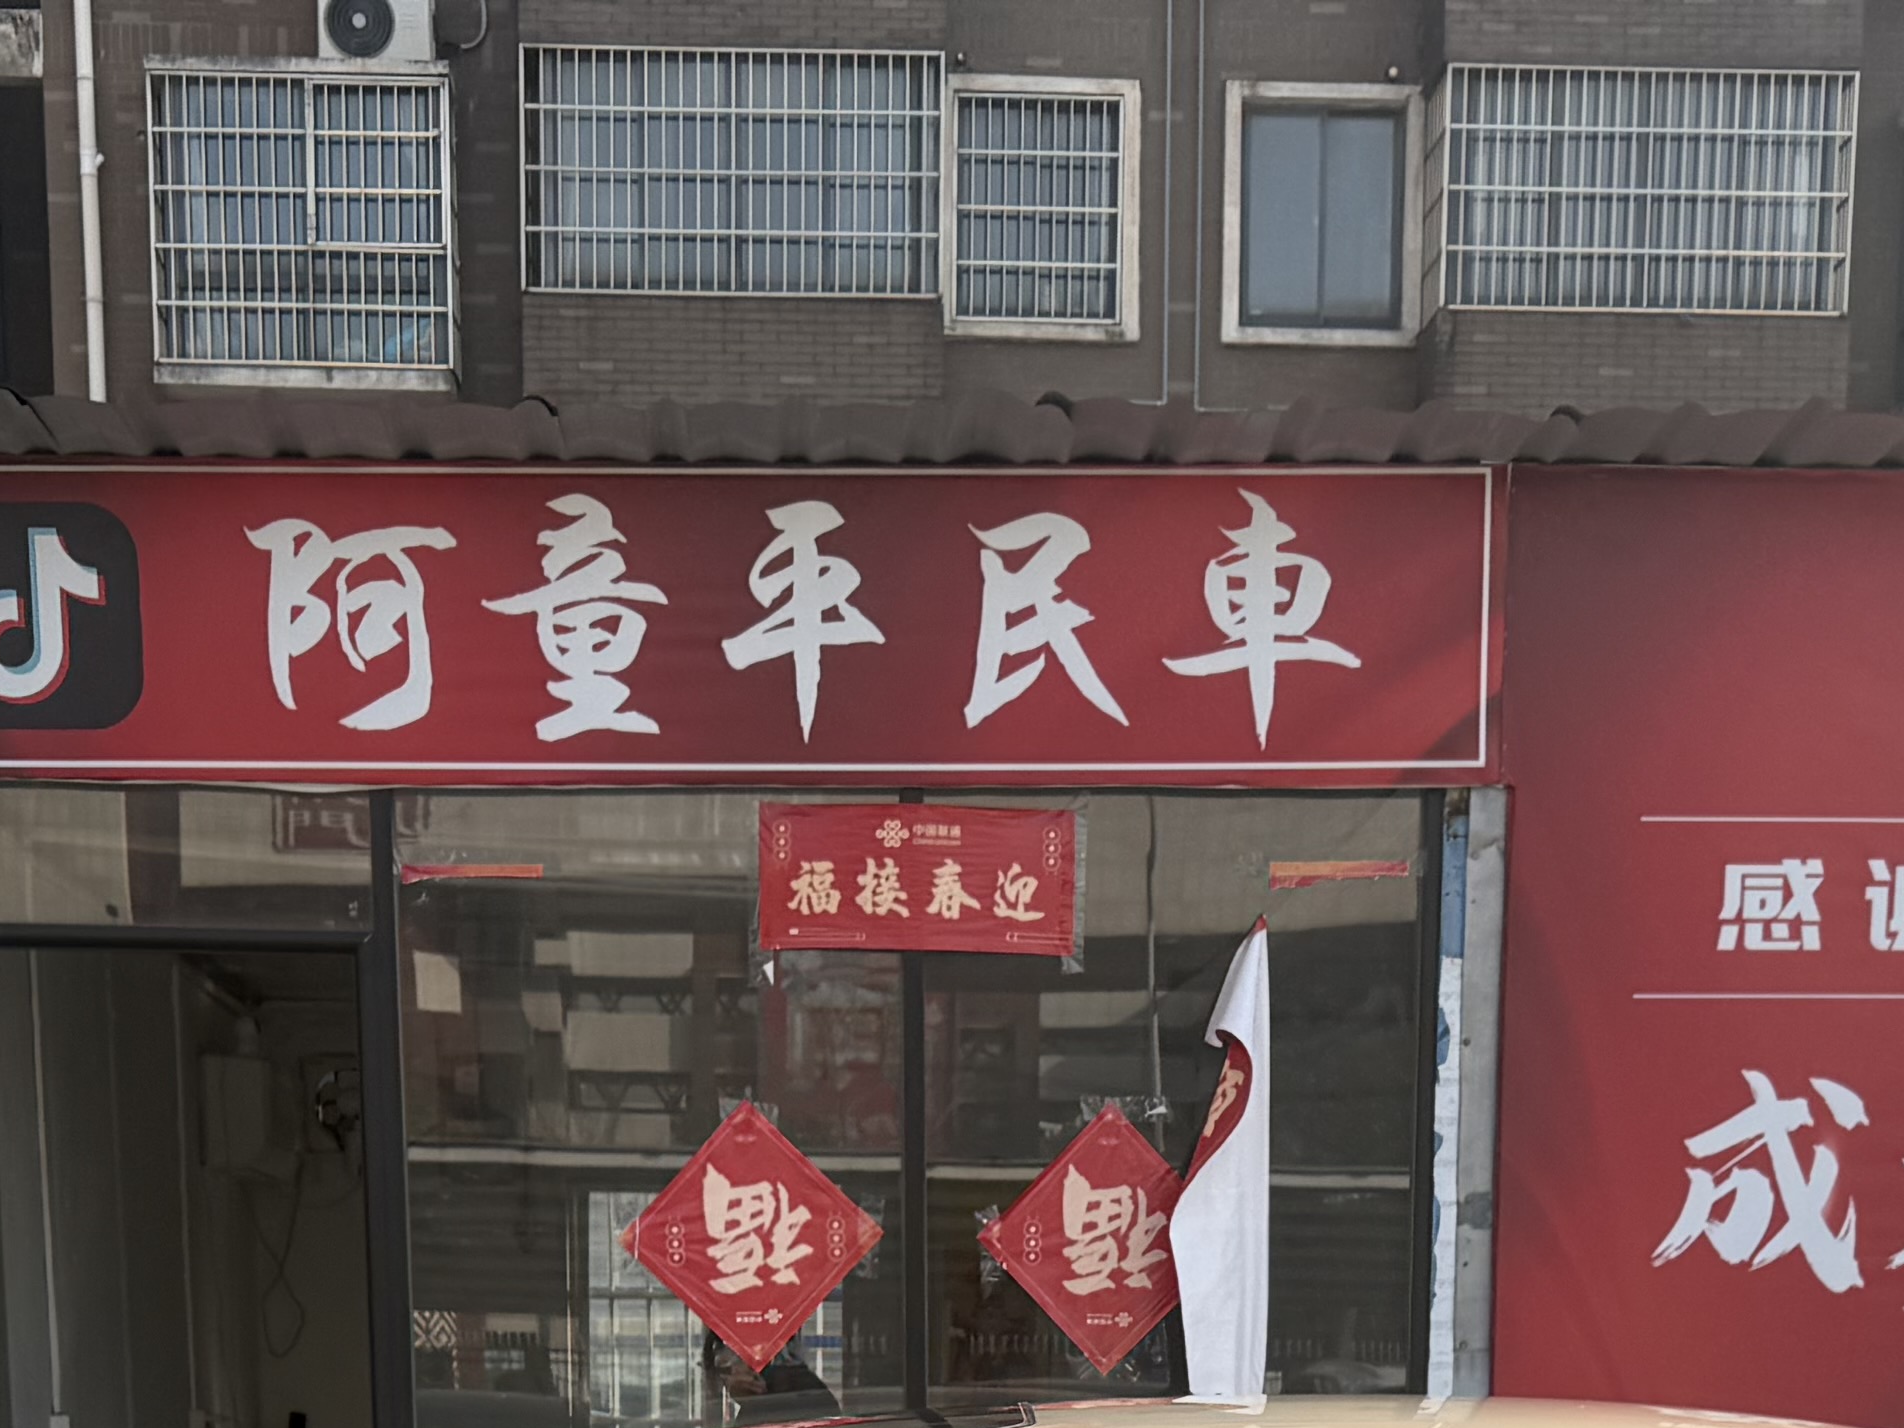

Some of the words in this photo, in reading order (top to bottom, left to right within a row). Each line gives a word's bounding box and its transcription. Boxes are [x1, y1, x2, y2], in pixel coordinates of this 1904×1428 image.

[245, 488, 1362, 752] 阿童平民車
[703, 1162, 814, 1295] 福
[1062, 1164, 1168, 1296] 福
